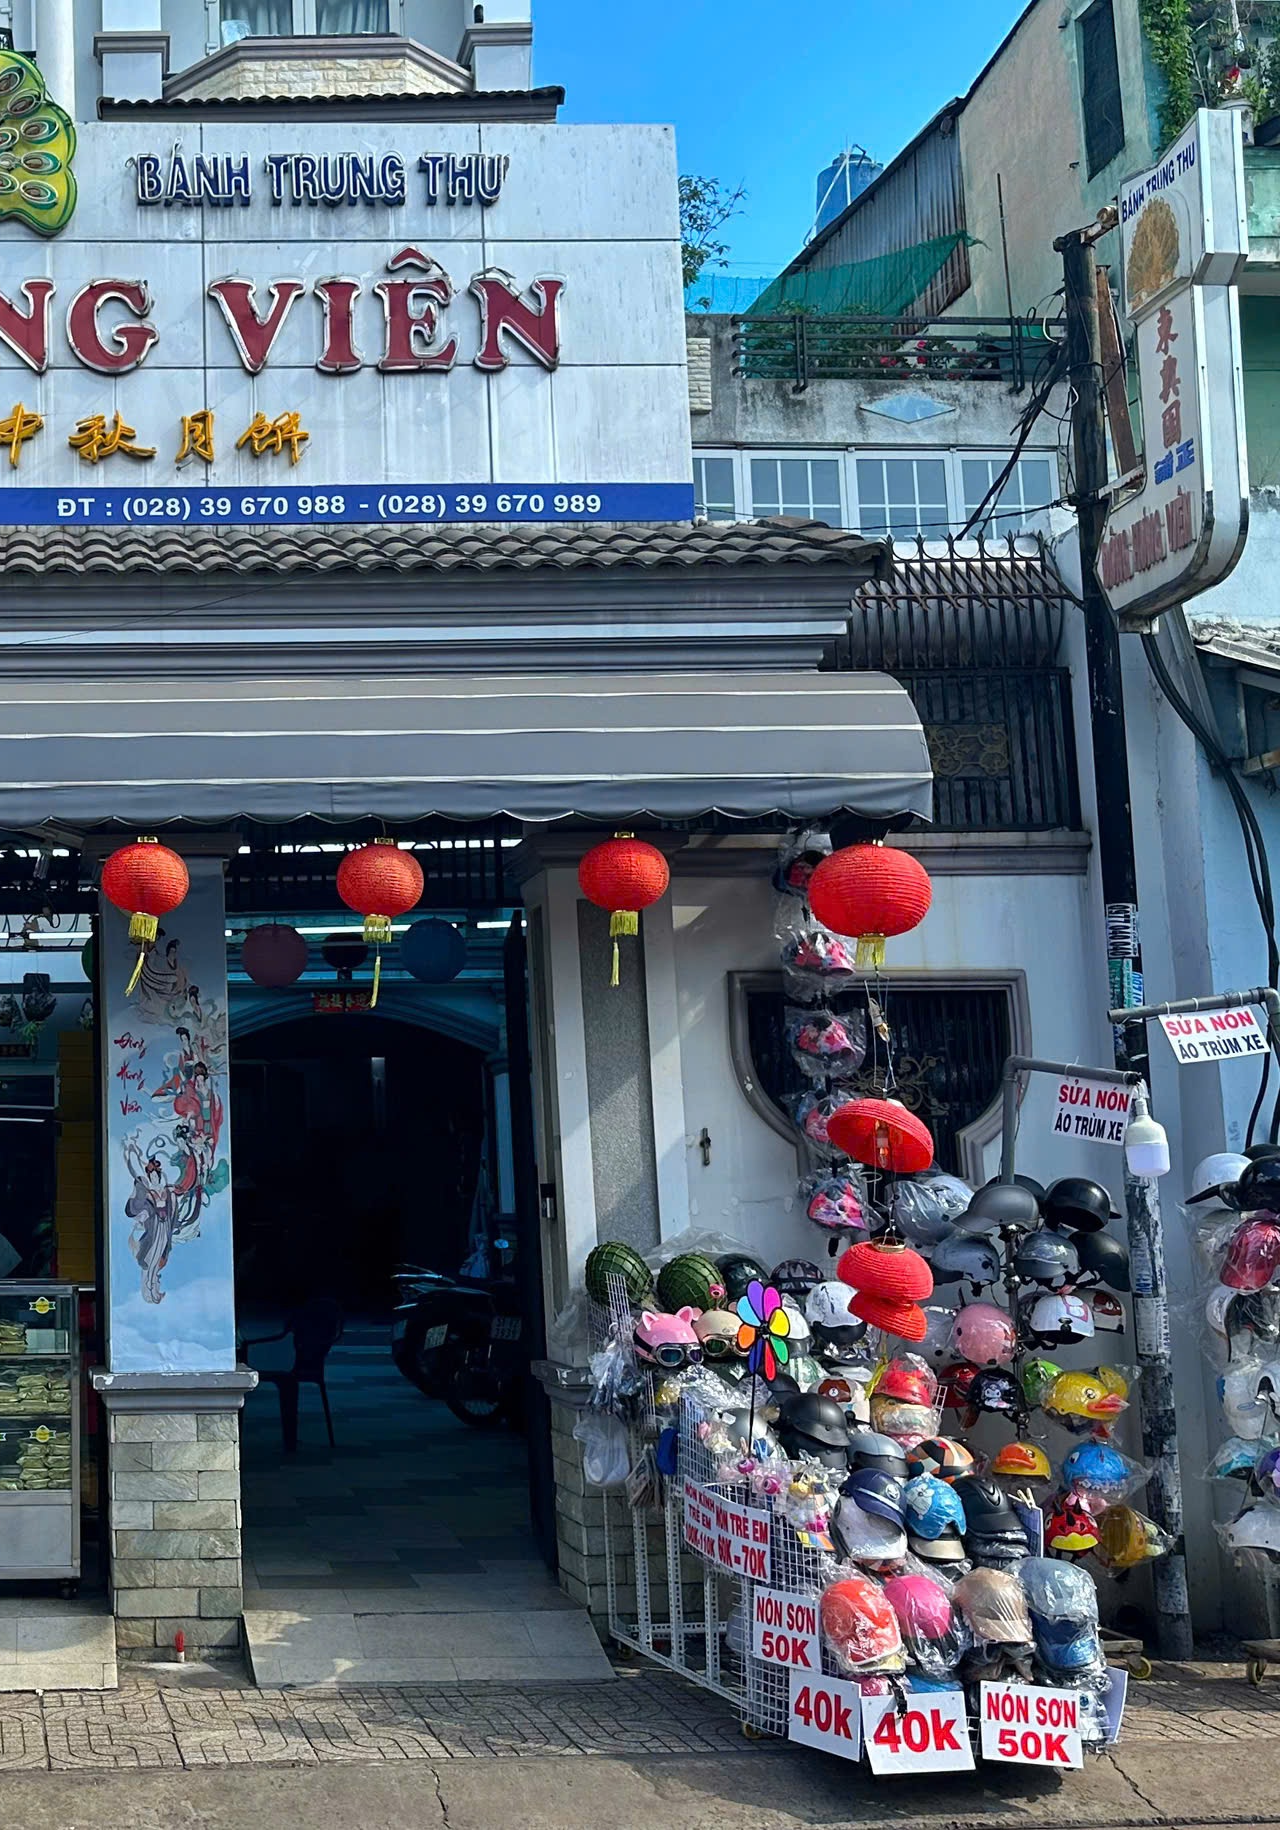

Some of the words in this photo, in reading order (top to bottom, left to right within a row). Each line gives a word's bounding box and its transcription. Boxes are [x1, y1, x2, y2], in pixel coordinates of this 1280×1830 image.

[135, 137, 251, 207] BÁNH
[264, 151, 407, 207] TRUNG
[418, 151, 510, 207] THU
[1121, 184, 1144, 223] BÁNH
[1146, 159, 1175, 196] TRUNG
[1176, 141, 1195, 176] THU
[207, 244, 568, 375] VIÊN
[57, 498, 95, 517] ĐT
[122, 497, 190, 521] (028)
[200, 497, 231, 516] 39
[240, 497, 288, 515] 670
[297, 495, 345, 515] 988
[377, 494, 446, 518] (028)
[455, 495, 487, 513] 39
[496, 494, 545, 513] 670
[553, 494, 602, 513] 989
[1165, 1014, 1208, 1036] SỬA
[1209, 1010, 1254, 1031] NÓN
[1178, 1040, 1199, 1059] ÁO
[1199, 1035, 1242, 1057] TRÙM
[1241, 1034, 1264, 1051] XE
[1059, 1079, 1090, 1107] SỬA
[1095, 1087, 1129, 1112] NÓN
[1054, 1108, 1071, 1133] ÁO
[1075, 1113, 1106, 1138] TRÙM
[1107, 1120, 1123, 1141] XE
[702, 1512, 711, 1530] EM
[729, 1508, 749, 1539] TRẺ
[752, 1519, 768, 1545] EM
[756, 1591, 783, 1627] NÓN
[786, 1602, 816, 1636] SƠN
[761, 1630, 812, 1668] 50K
[794, 1685, 852, 1741] 40k
[986, 1685, 1028, 1724] NÓN
[1036, 1695, 1077, 1729] SƠN
[873, 1707, 962, 1754] 40k
[997, 1728, 1070, 1763] 50K
